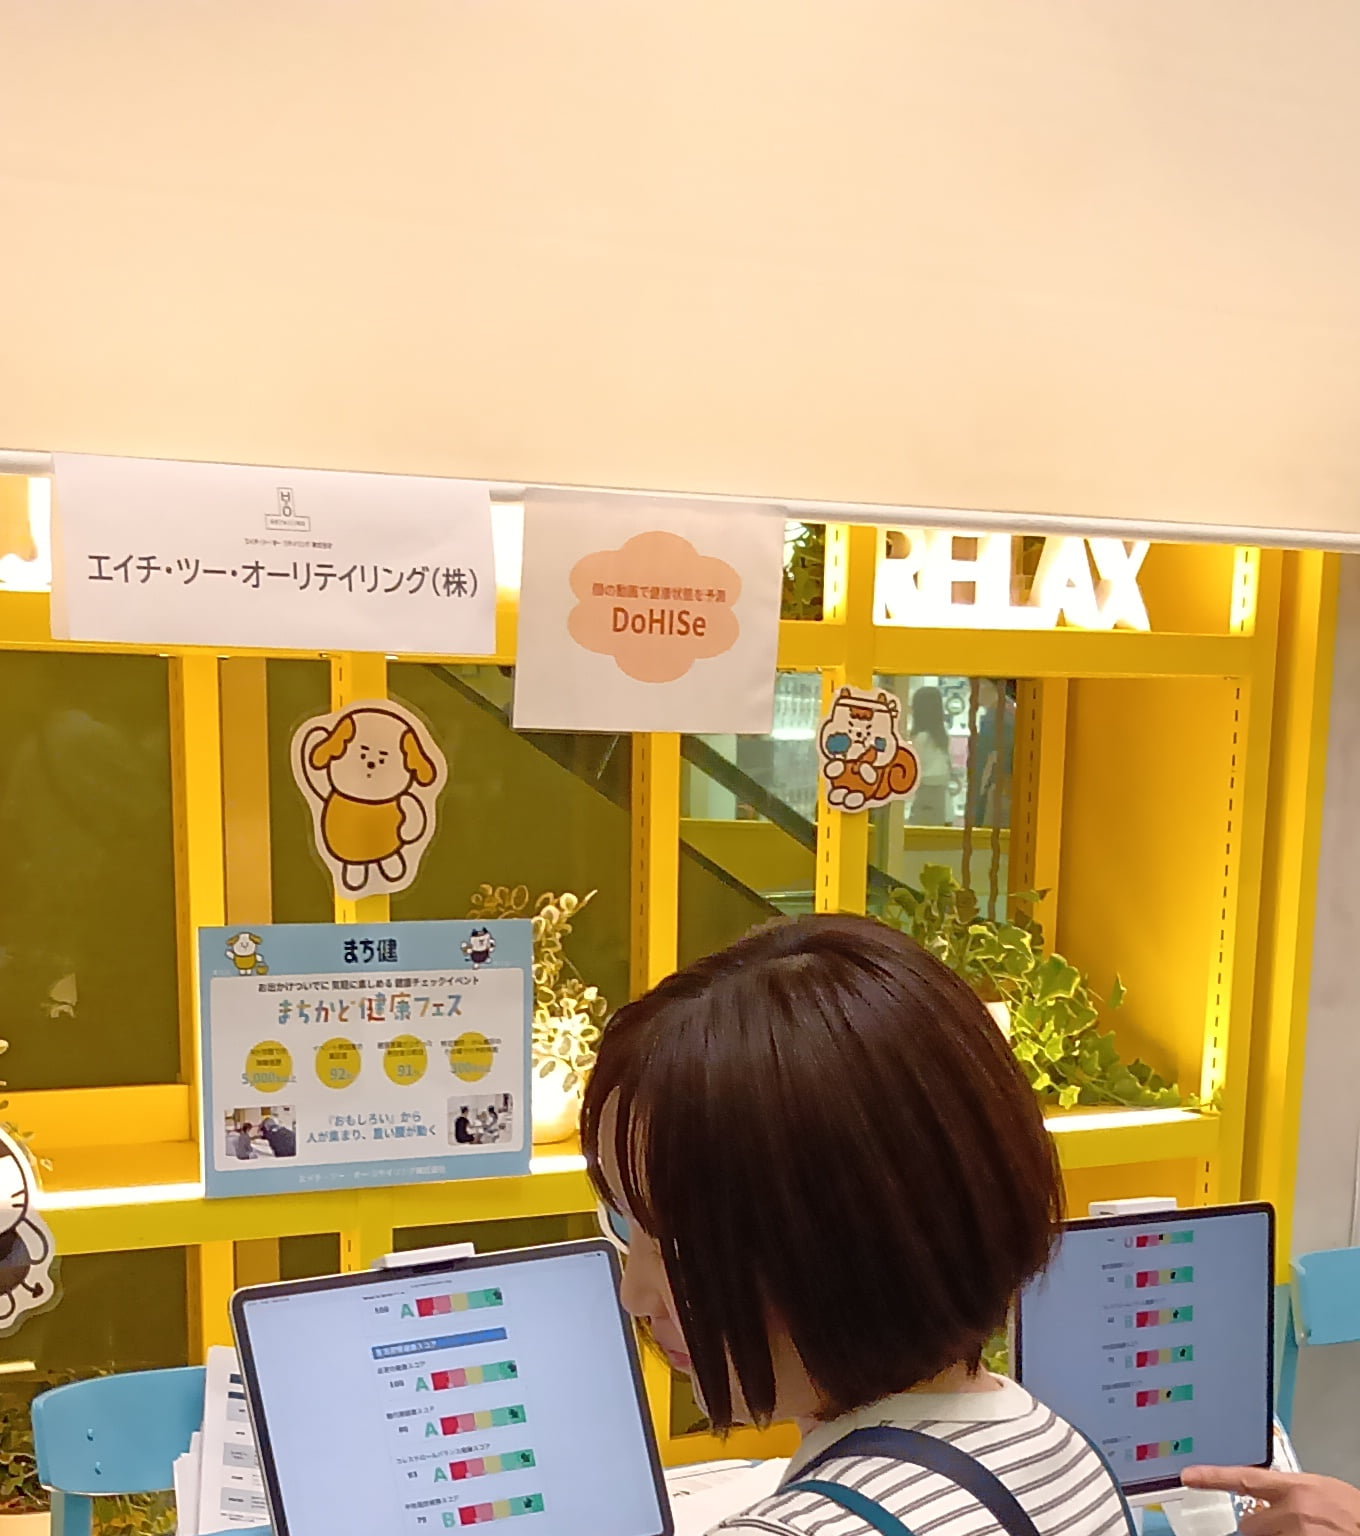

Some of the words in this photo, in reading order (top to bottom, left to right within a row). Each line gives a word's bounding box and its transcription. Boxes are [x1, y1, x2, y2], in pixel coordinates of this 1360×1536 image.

[873, 526, 1151, 632] RELAX
[612, 606, 707, 637] DoHISe
[343, 938, 399, 963] まち健
[277, 991, 464, 1025] まちかど健康フェス
[400, 1303, 415, 1319] A
[415, 1376, 430, 1393] A
[425, 1421, 439, 1438] A
[433, 1466, 448, 1483] A
[441, 1511, 456, 1528] B
